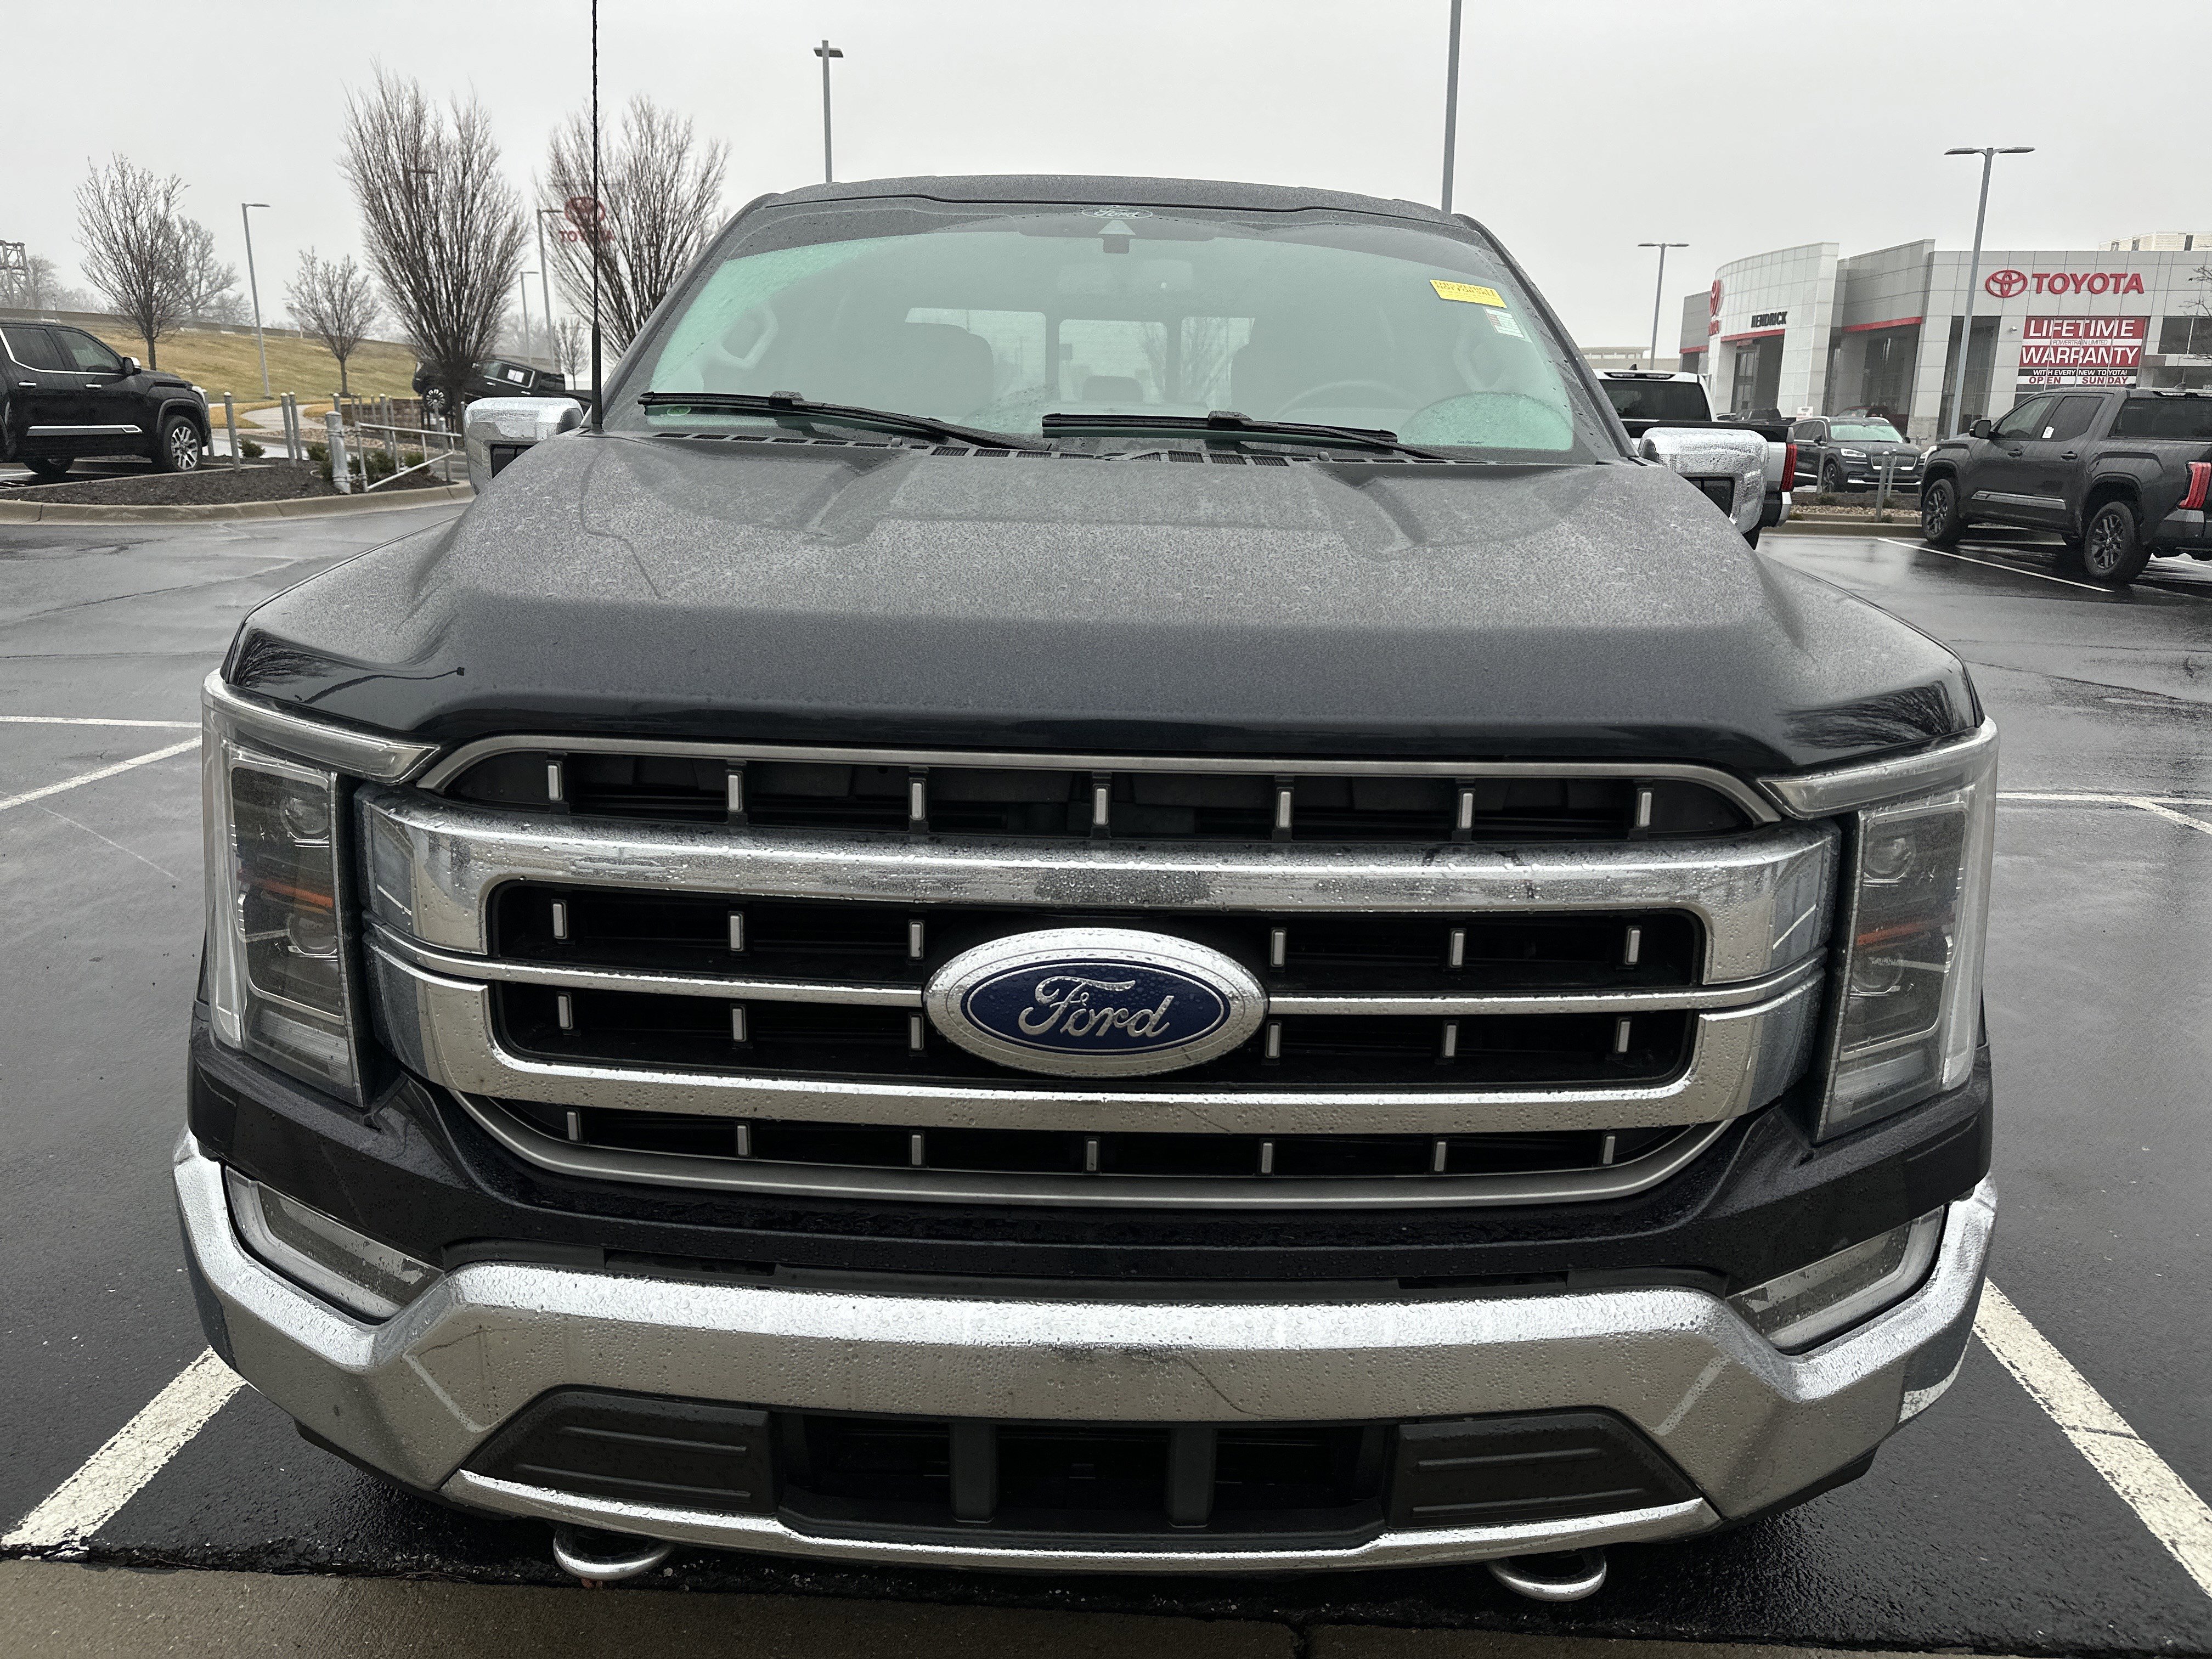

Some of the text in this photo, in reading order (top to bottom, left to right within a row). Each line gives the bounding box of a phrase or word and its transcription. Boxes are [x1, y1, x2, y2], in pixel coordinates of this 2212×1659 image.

[1094, 208, 1139, 217] Ford
[2032, 273, 2145, 294] TOYOTA
[1751, 311, 1787, 328] HENDRICK
[2029, 320, 2135, 337] LIFETIME
[2022, 347, 2138, 364] WARRANTY
[1018, 975, 1174, 1038] Ford
